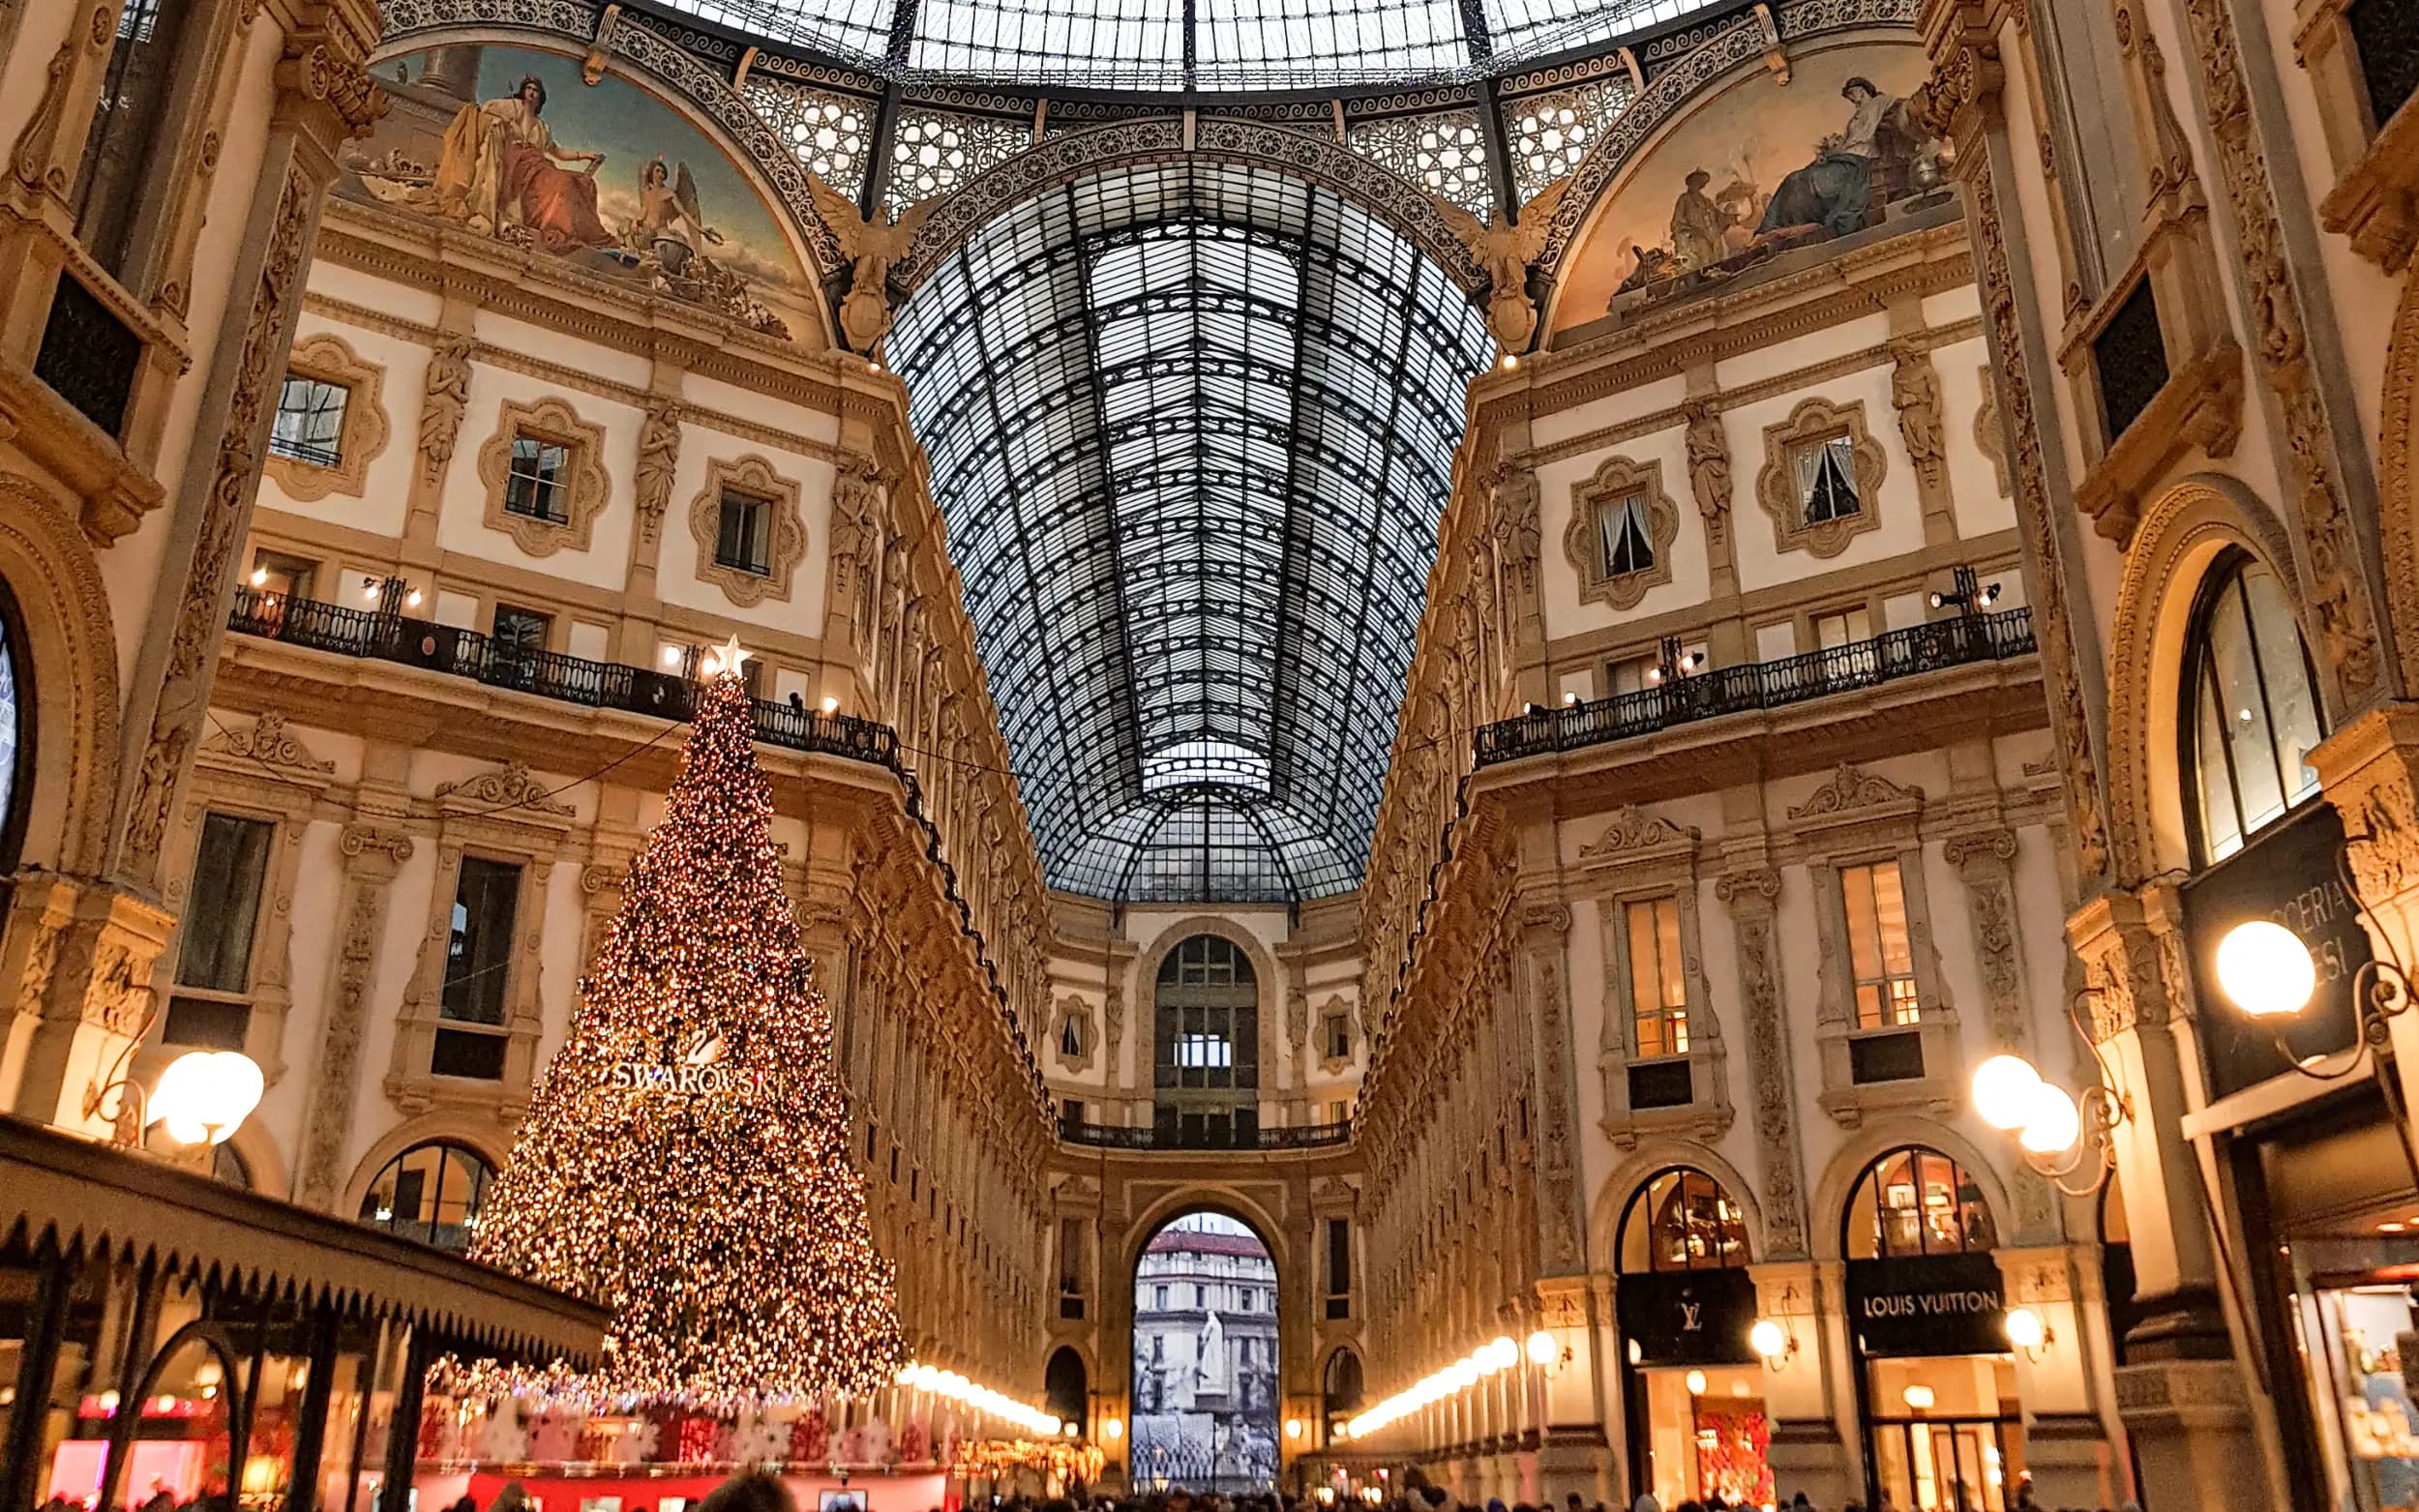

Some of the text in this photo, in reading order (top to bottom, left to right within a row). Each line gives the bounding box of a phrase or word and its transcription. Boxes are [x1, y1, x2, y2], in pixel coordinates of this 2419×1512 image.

[612, 1061, 784, 1097] SWAROVSKI
[1681, 1302, 1703, 1331] LV
[1864, 1290, 1999, 1318] LOUIS VUITTON
